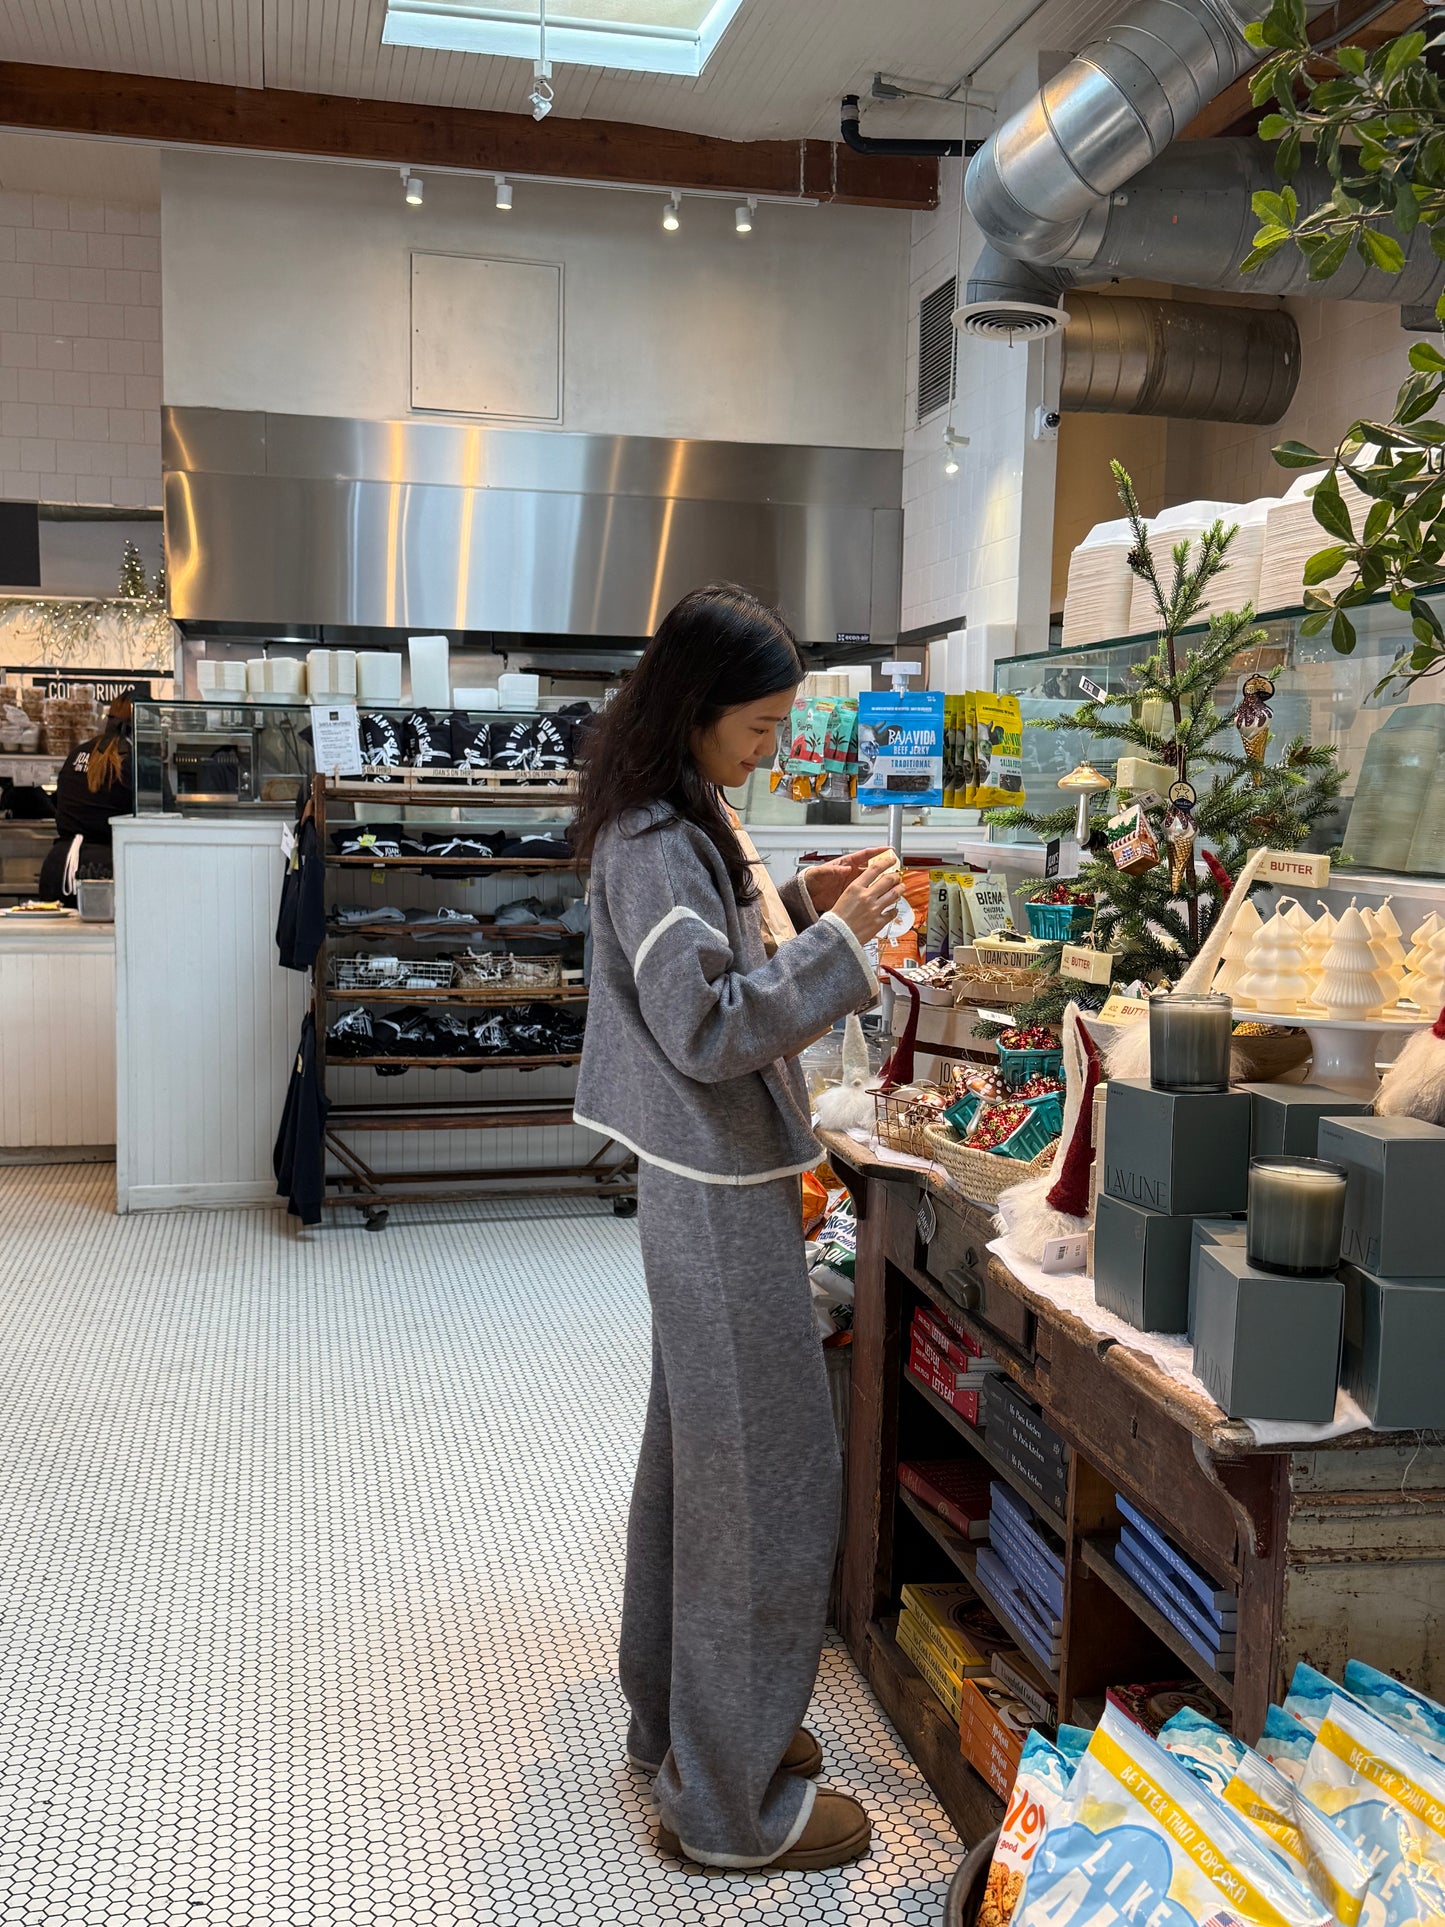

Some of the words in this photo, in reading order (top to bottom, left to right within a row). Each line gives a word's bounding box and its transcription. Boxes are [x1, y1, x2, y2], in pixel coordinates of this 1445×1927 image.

[538, 717, 565, 753] JOAN'S
[893, 746, 909, 755] BEEF
[910, 746, 930, 755] JERKY
[891, 759, 931, 768] TRADITIONAL
[1270, 861, 1313, 875] BUTTER
[976, 891, 1005, 905] BIENA
[982, 949, 1009, 967] JOAN'S
[1010, 952, 1022, 967] ON
[1071, 956, 1091, 970] BUTTER
[1120, 1005, 1149, 1017] BUTT
[1105, 1164, 1168, 1208] LAVUNE
[1341, 1226, 1379, 1269] UNE
[931, 1375, 945, 1397] LET'S
[943, 1386, 955, 1404] EAT
[1349, 1746, 1397, 1789] BETTER
[1398, 1779, 1427, 1811] THAN
[1119, 1764, 1169, 1815] BETTER
[1166, 1809, 1197, 1845] THAN
[1191, 1841, 1248, 1905] POPCORN
[1000, 1840, 1018, 1854] good
[1081, 1838, 1173, 1927] LIKE
